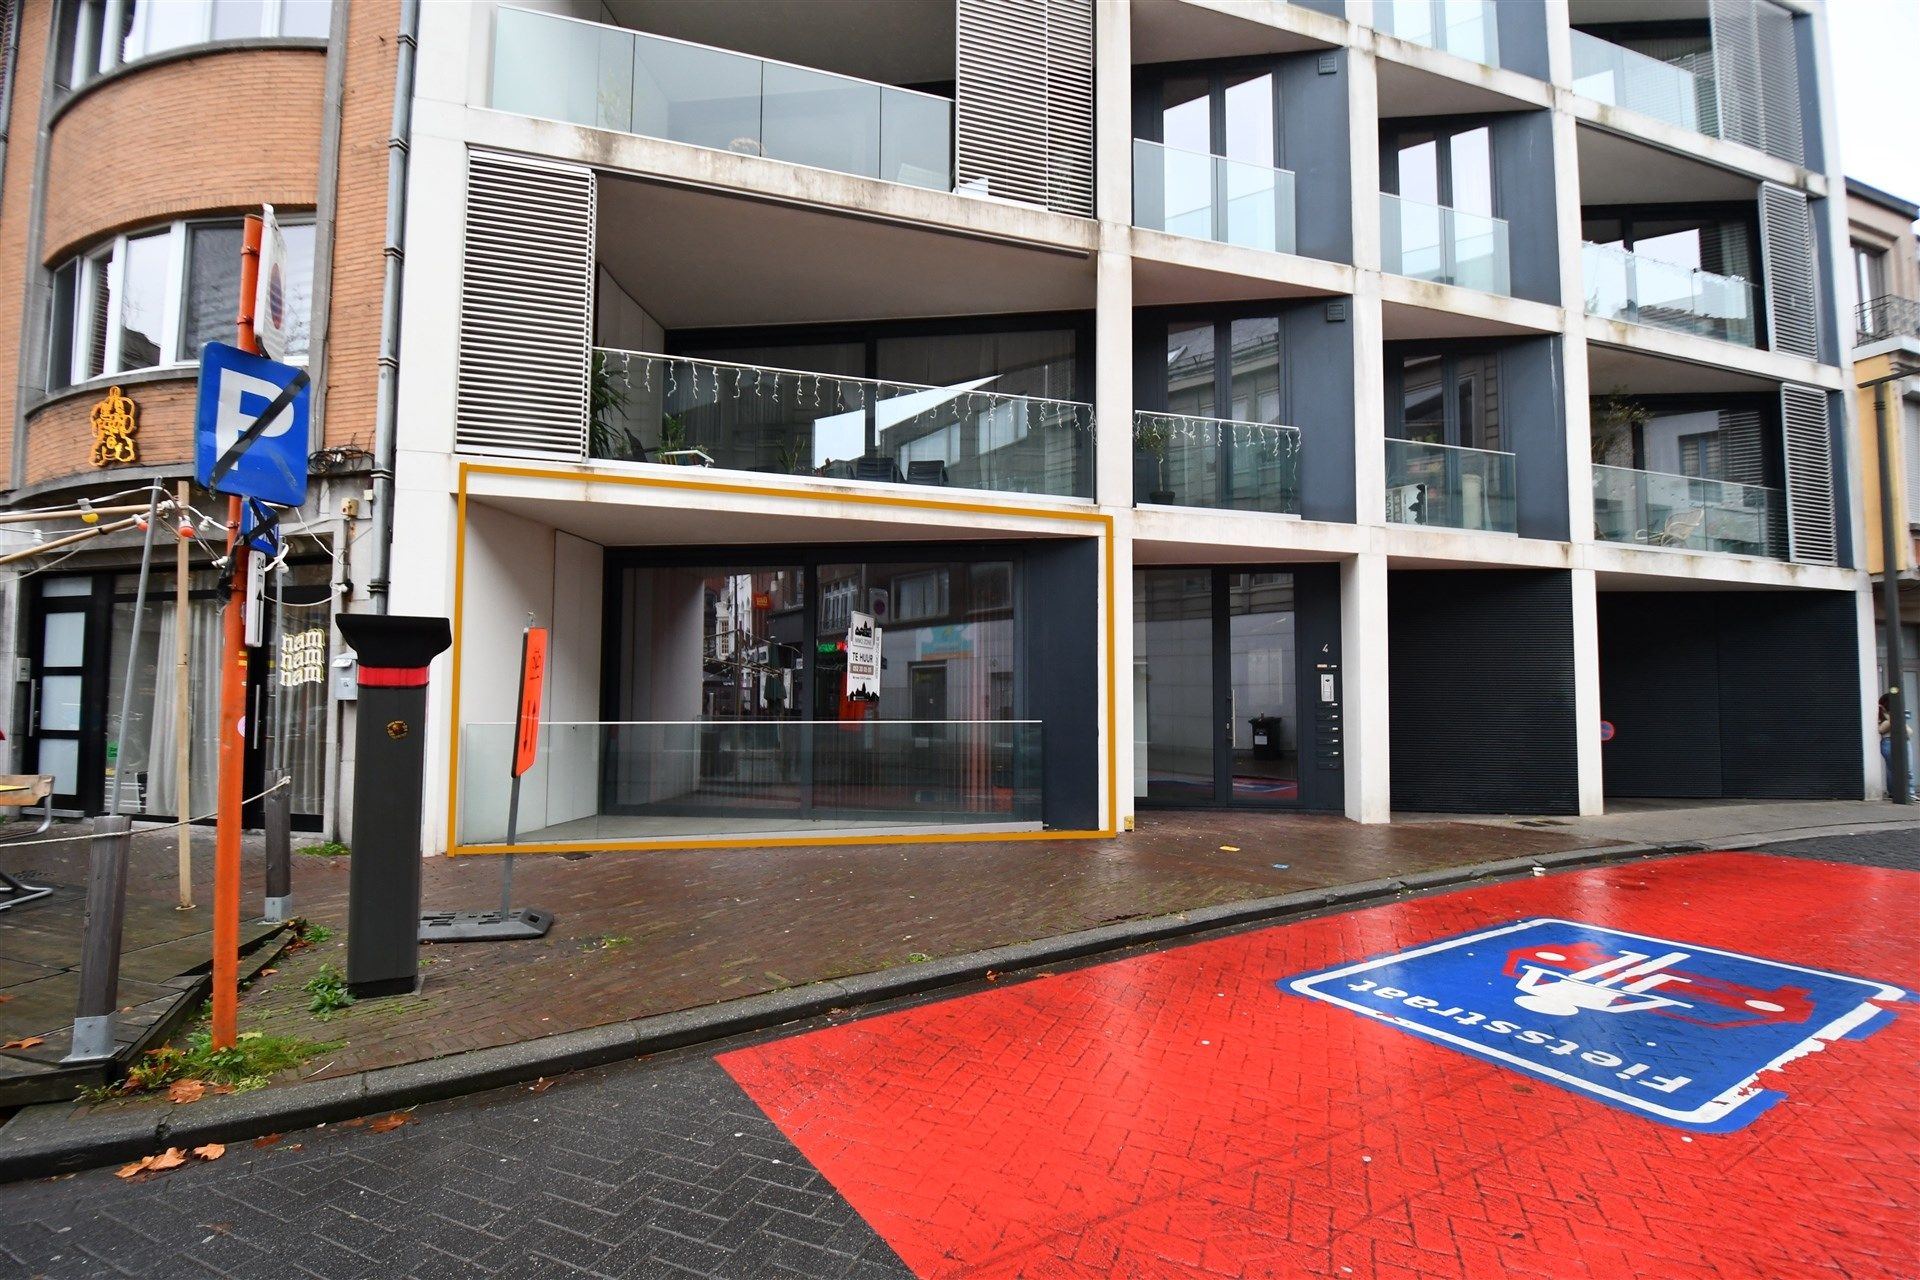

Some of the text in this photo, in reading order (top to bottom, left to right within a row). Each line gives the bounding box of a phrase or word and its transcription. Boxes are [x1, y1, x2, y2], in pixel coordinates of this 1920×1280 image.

[256, 556, 266, 569] 24
[281, 628, 325, 652] nam
[1321, 643, 1329, 653] 4
[280, 645, 325, 670] nam
[279, 664, 324, 687] nam
[1347, 979, 1693, 1094] Fietsstraat
